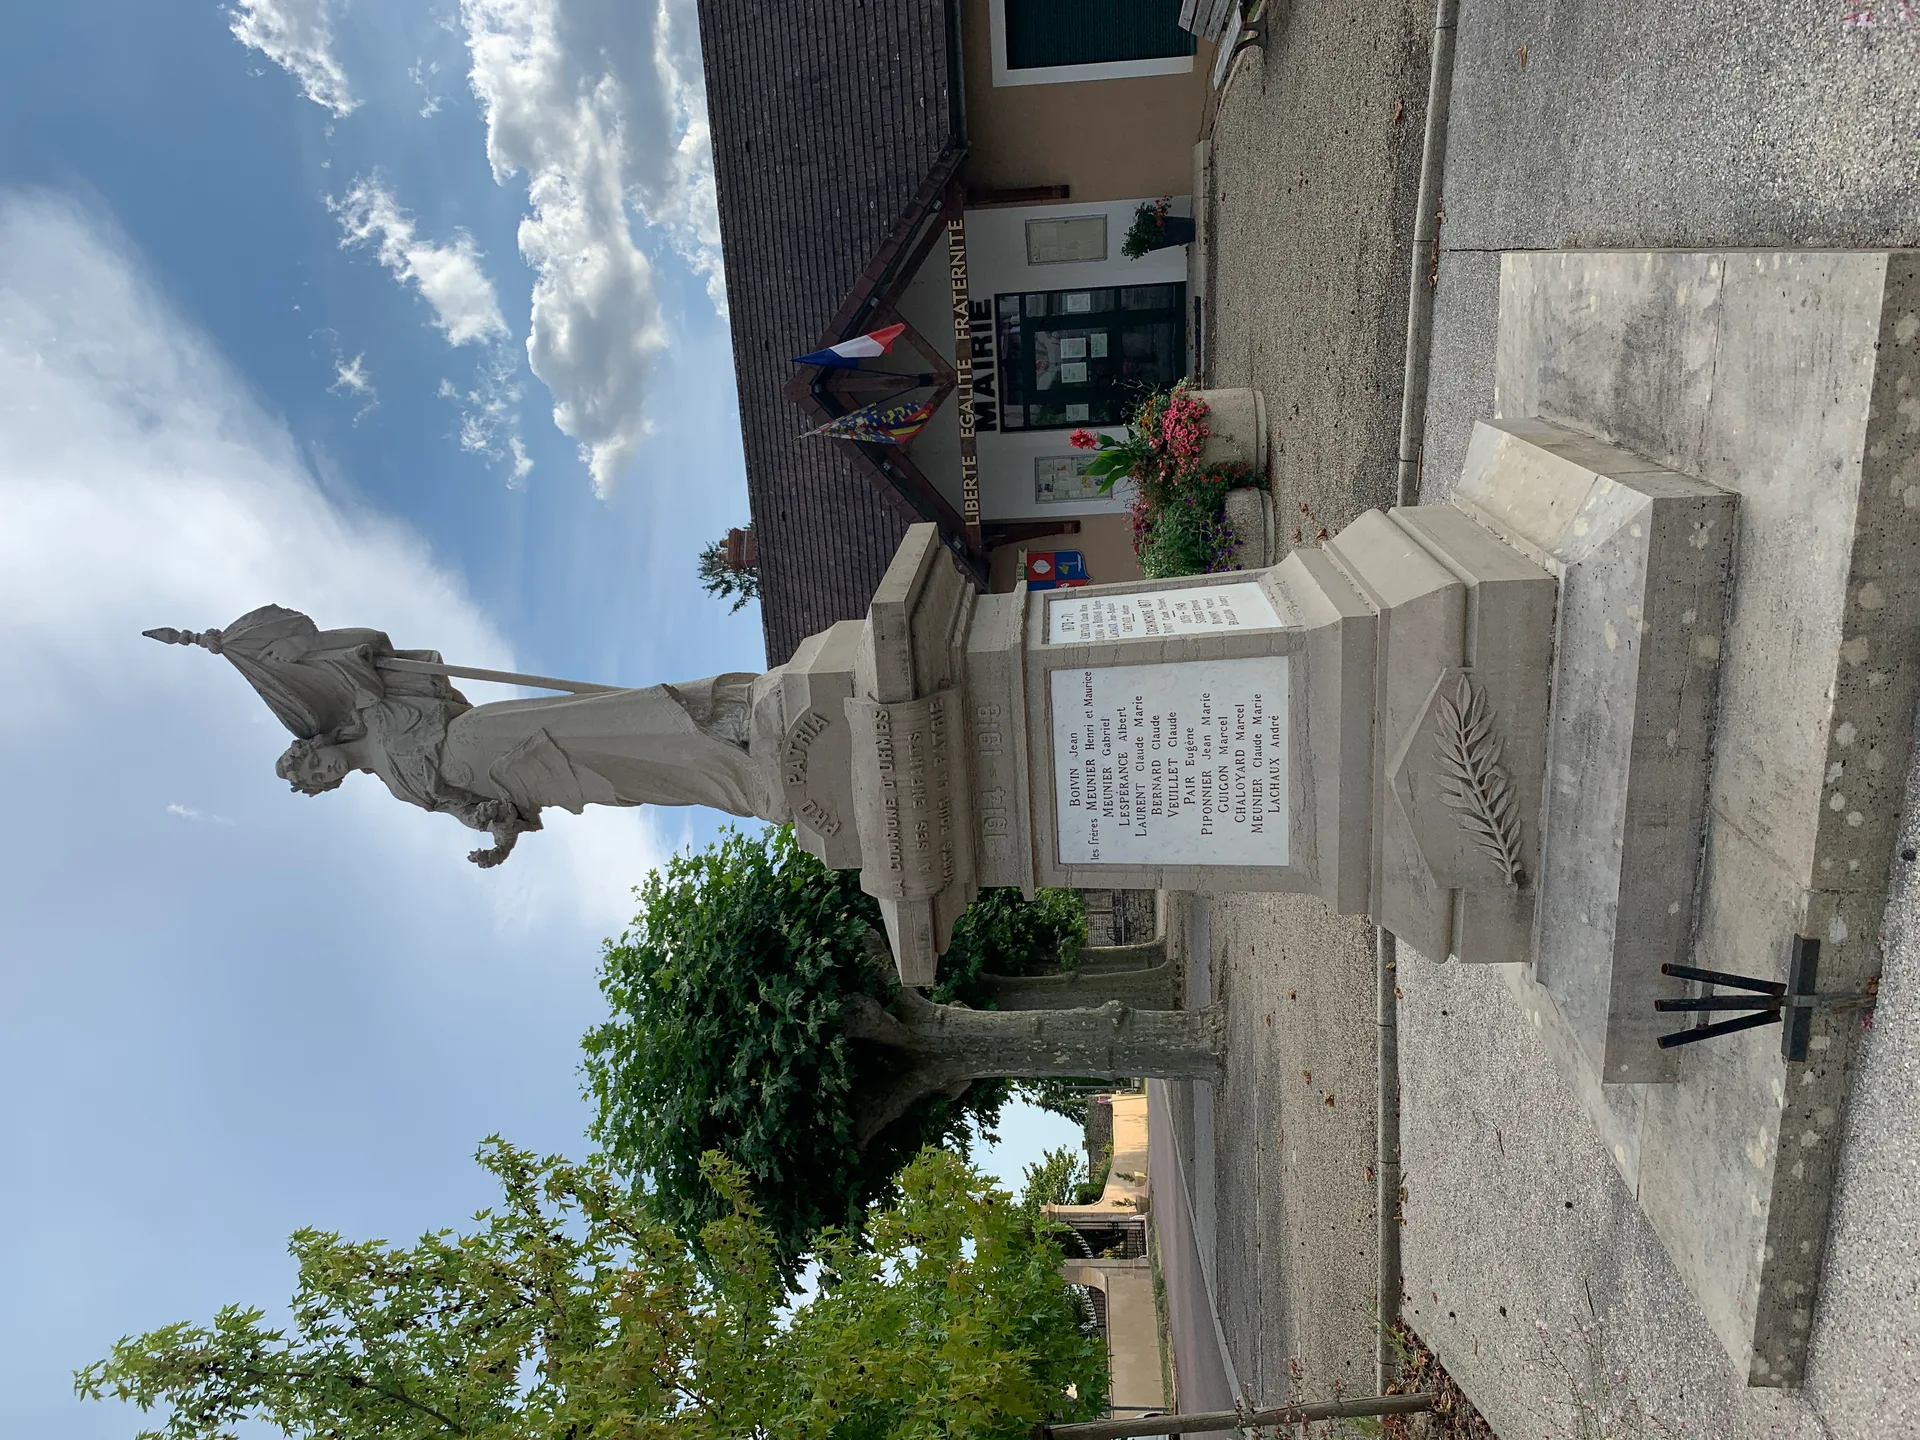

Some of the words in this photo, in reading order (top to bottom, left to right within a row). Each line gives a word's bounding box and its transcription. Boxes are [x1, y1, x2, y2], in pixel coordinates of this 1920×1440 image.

[949, 219, 970, 340] FRATERNITE
[969, 299, 996, 432] MAIRIE
[957, 359, 976, 438] EGALITE
[962, 456, 980, 526] LIBERTE
[1016, 565, 1024, 581] ES
[1082, 672, 1093, 706] Maurice
[1085, 710, 1093, 718] et
[1116, 707, 1127, 741] Albert
[1132, 696, 1143, 727] Marie
[1200, 693, 1211, 725] Marie
[1234, 704, 1245, 740] Marcel
[1252, 694, 1262, 724] Marie
[785, 711, 830, 786] PATRIA
[930, 700, 946, 767] PATRIE
[976, 704, 1003, 756] 1918
[1069, 733, 1078, 759] Jean
[1084, 725, 1094, 750] Henri
[1100, 716, 1113, 756] Gabriel
[1150, 715, 1161, 750] Claude
[1167, 712, 1177, 747] Claude
[1184, 728, 1198, 766] Eugène
[1202, 735, 1211, 760] Jean
[1218, 717, 1230, 754] Marcel
[1268, 716, 1279, 748] André
[874, 709, 895, 789] D'ORMES
[1132, 737, 1145, 772] Claude
[1252, 734, 1262, 768] Claude
[908, 732, 925, 809] ENFANTS
[935, 773, 949, 790] LA
[1069, 768, 1080, 806] BOIVIN
[1083, 757, 1099, 813] MEUNIER
[1149, 758, 1164, 817] BERNARD
[1167, 758, 1179, 818] VEUILLET
[1218, 766, 1229, 813] GUIGON
[1233, 750, 1247, 823] CHALOYARD
[1268, 758, 1280, 813] LACHAUX
[1102, 767, 1114, 817] MEUNIER
[1116, 752, 1131, 828] LESPÉRANCE
[1184, 776, 1197, 805] PAIR
[1201, 770, 1213, 835] PIPONNIER
[1251, 779, 1263, 833] MEUNIER
[799, 799, 841, 837] PRO
[937, 797, 951, 835] POUR
[982, 786, 1008, 839] 1914
[1135, 783, 1147, 836] LAURENT
[885, 797, 901, 872] COMMUNE
[914, 821, 929, 850] SES
[1088, 818, 1099, 844] frères
[917, 861, 931, 873] A
[940, 841, 953, 885] MORTS
[1090, 849, 1099, 860] les
[892, 879, 904, 899] LA
